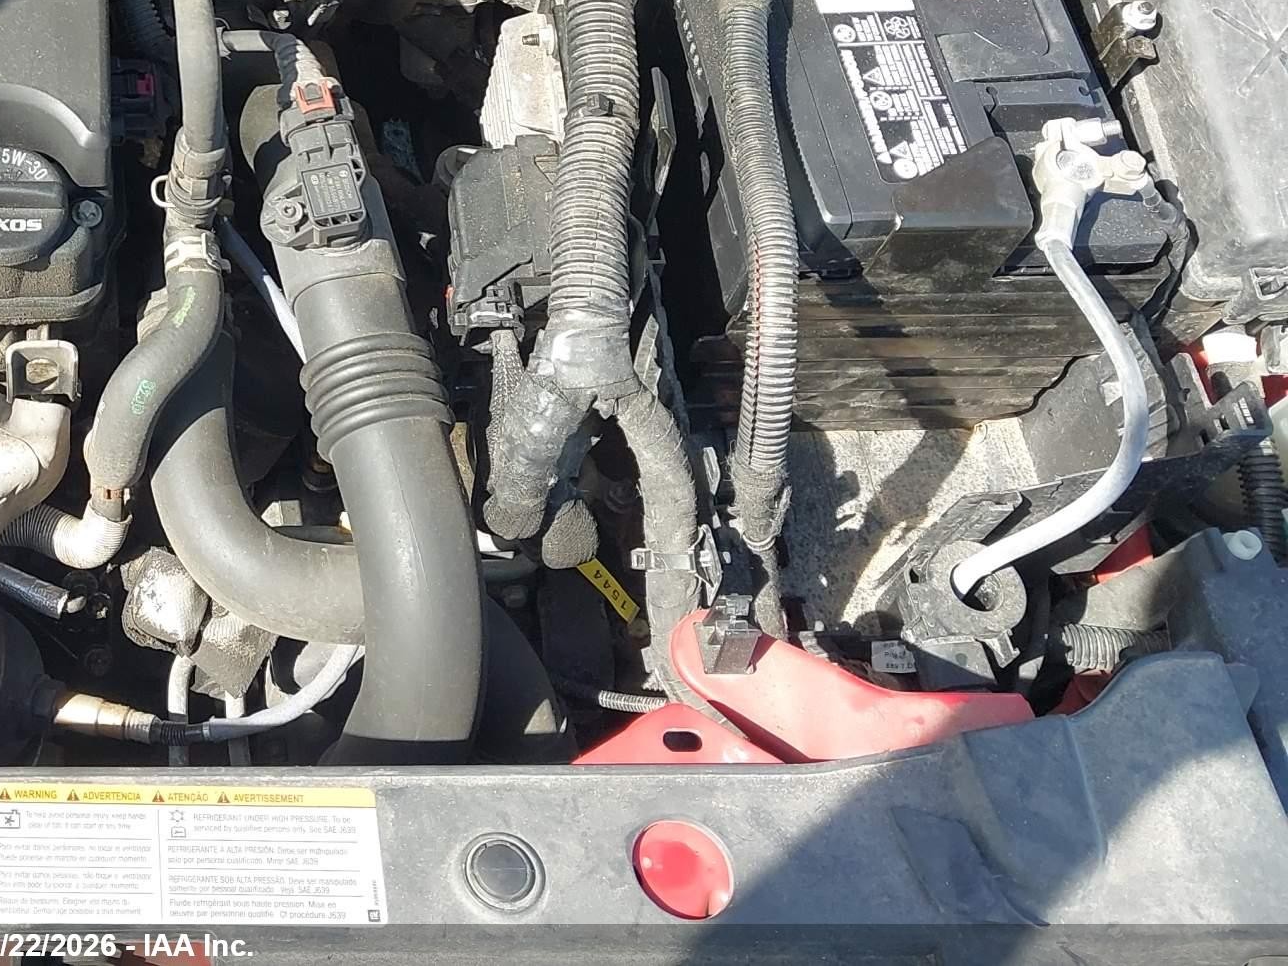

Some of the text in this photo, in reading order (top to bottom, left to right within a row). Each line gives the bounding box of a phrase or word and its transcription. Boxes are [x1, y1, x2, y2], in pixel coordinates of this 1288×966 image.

[1, 148, 48, 180] 5W-30
[14, 790, 57, 799] WARNING
[83, 791, 141, 801] ADVERTENCIA
[233, 794, 304, 803] AVERTISSEMENT
